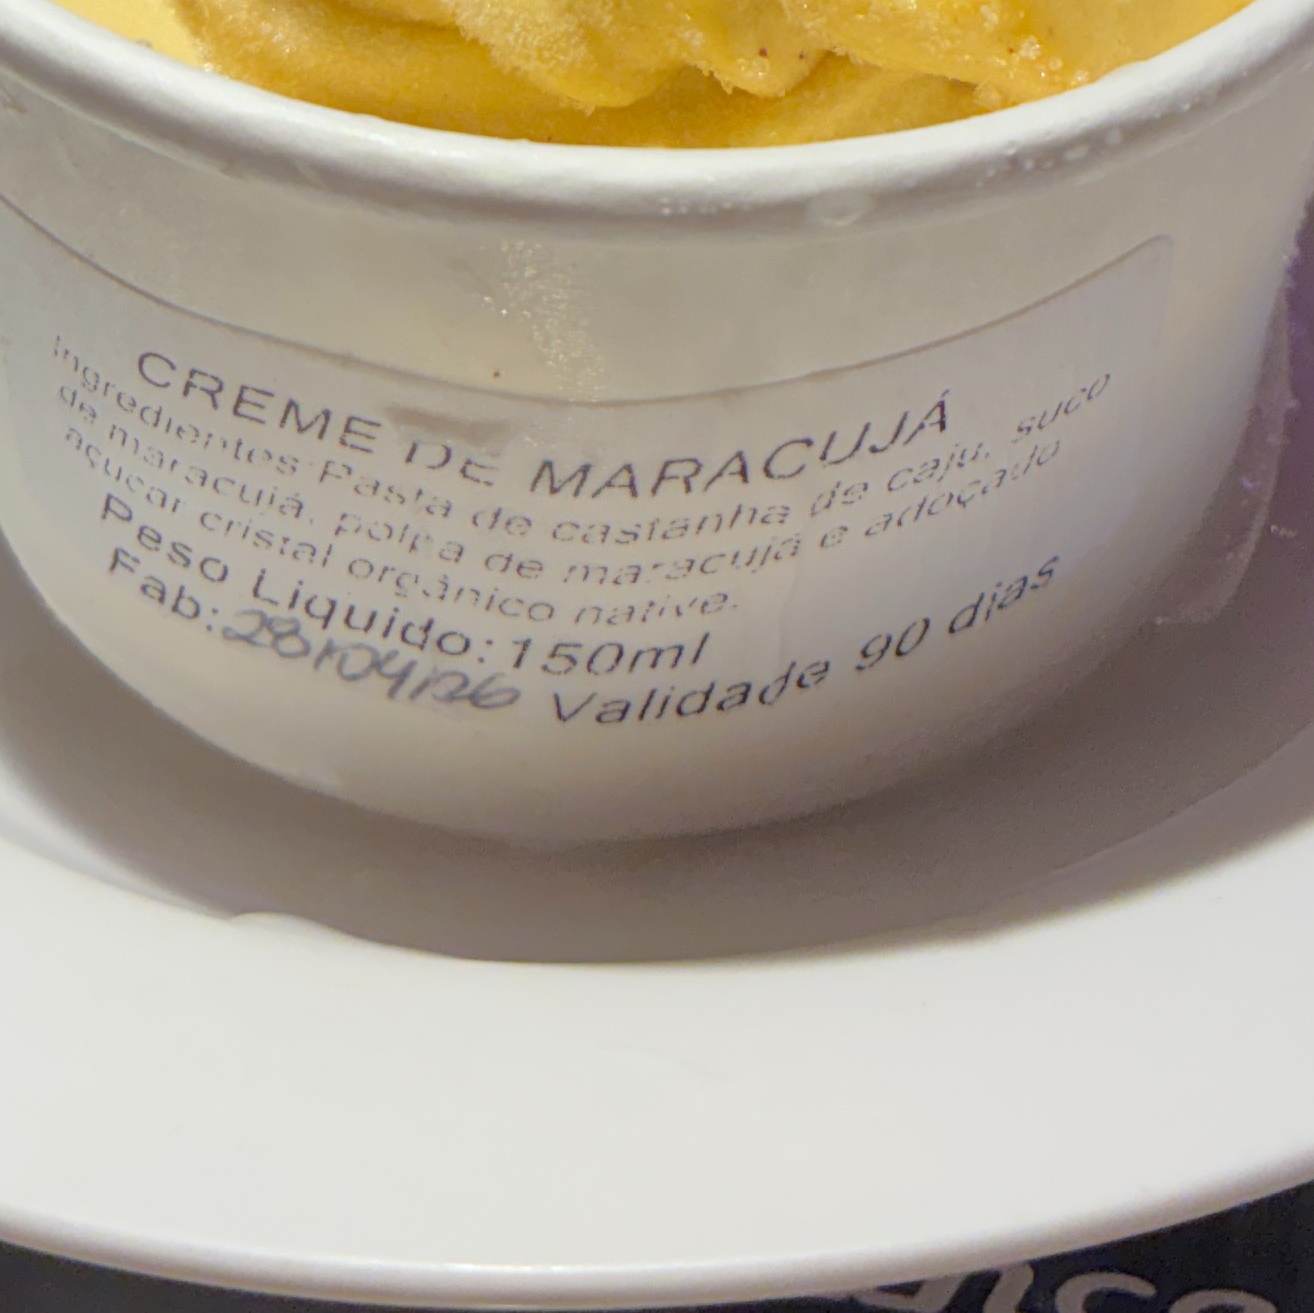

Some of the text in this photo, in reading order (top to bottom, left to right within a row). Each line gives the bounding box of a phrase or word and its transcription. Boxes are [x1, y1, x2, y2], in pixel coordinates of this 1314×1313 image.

[137, 351, 951, 498] CREME DE MARACUJÁ
[100, 492, 229, 584] Peso
[472, 506, 533, 537] de
[810, 480, 869, 518] de
[484, 553, 544, 580] de
[108, 546, 219, 632] Fab:
[551, 655, 831, 725] Validade
[853, 616, 931, 673] 90
[947, 554, 1061, 636] dias
